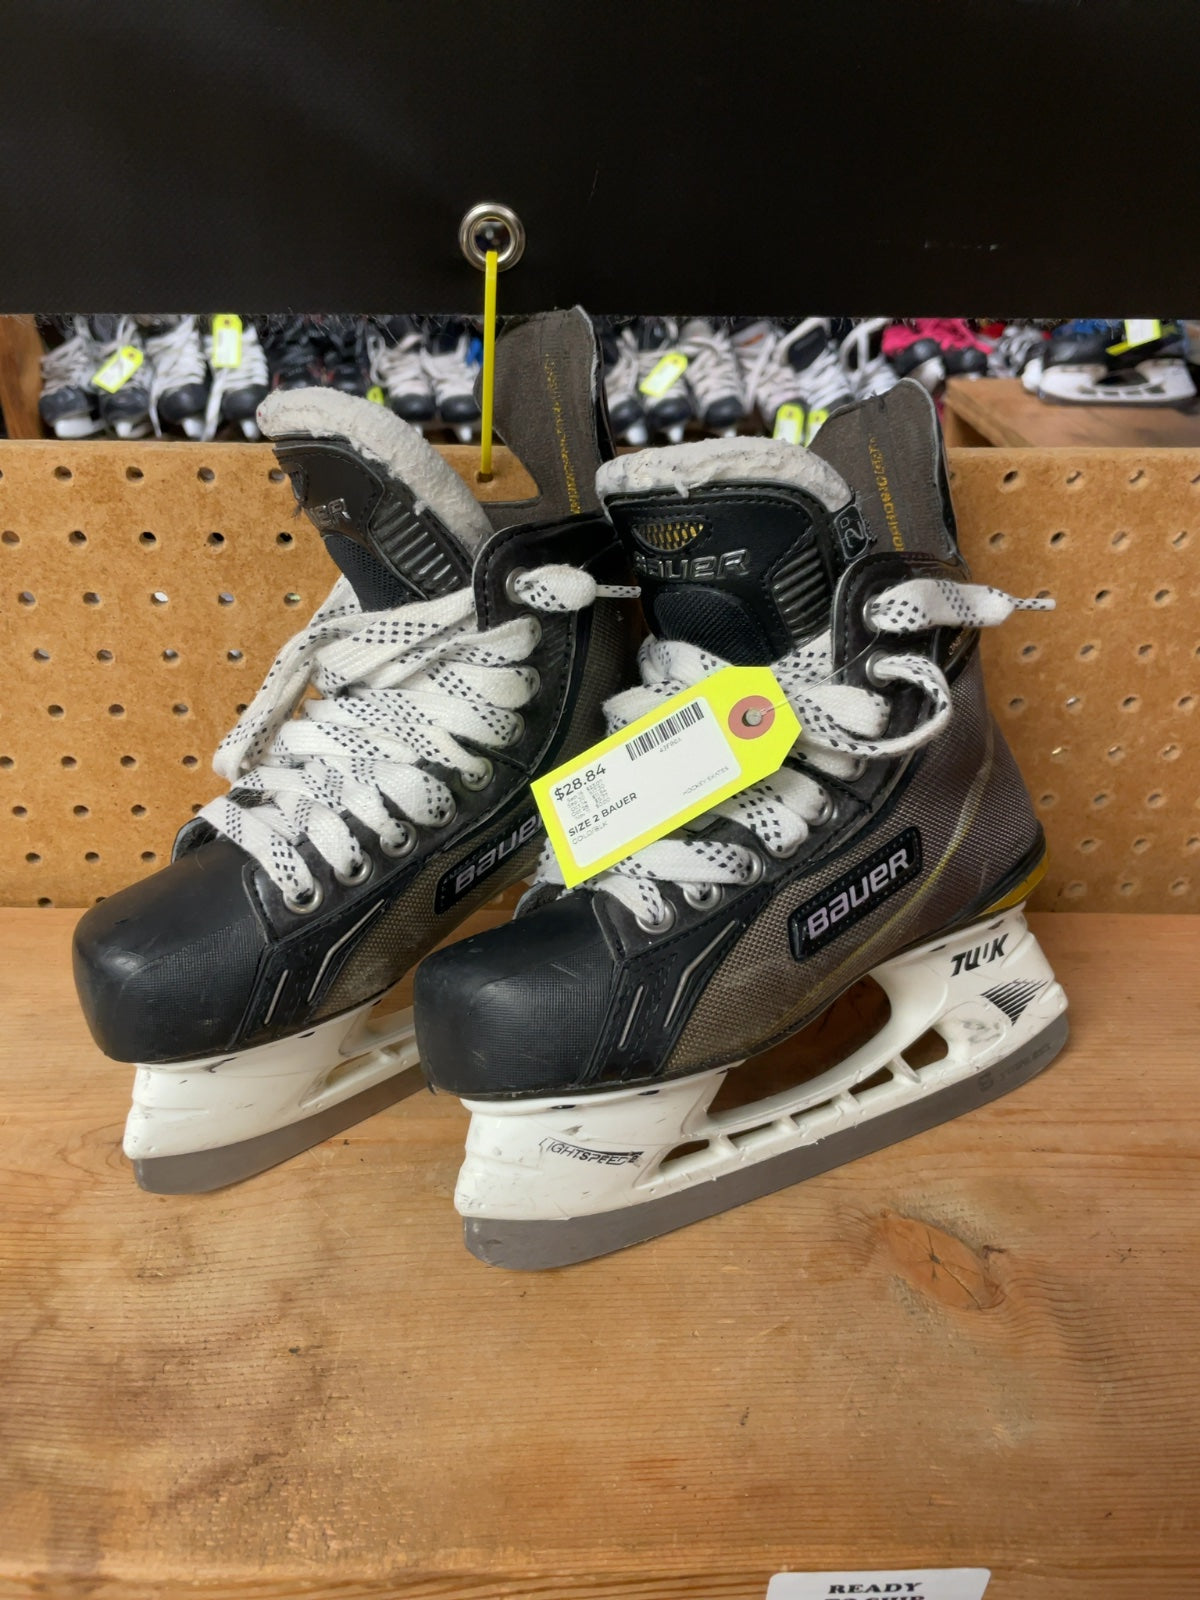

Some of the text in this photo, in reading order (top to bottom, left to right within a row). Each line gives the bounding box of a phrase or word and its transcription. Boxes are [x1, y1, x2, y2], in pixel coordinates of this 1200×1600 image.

[554, 763, 606, 801] $28.84
[568, 818, 592, 837] SIZE
[592, 813, 601, 823] 2
[601, 792, 637, 818] BAUER
[807, 848, 909, 940] BAUER
[828, 1582, 923, 1594] READY
